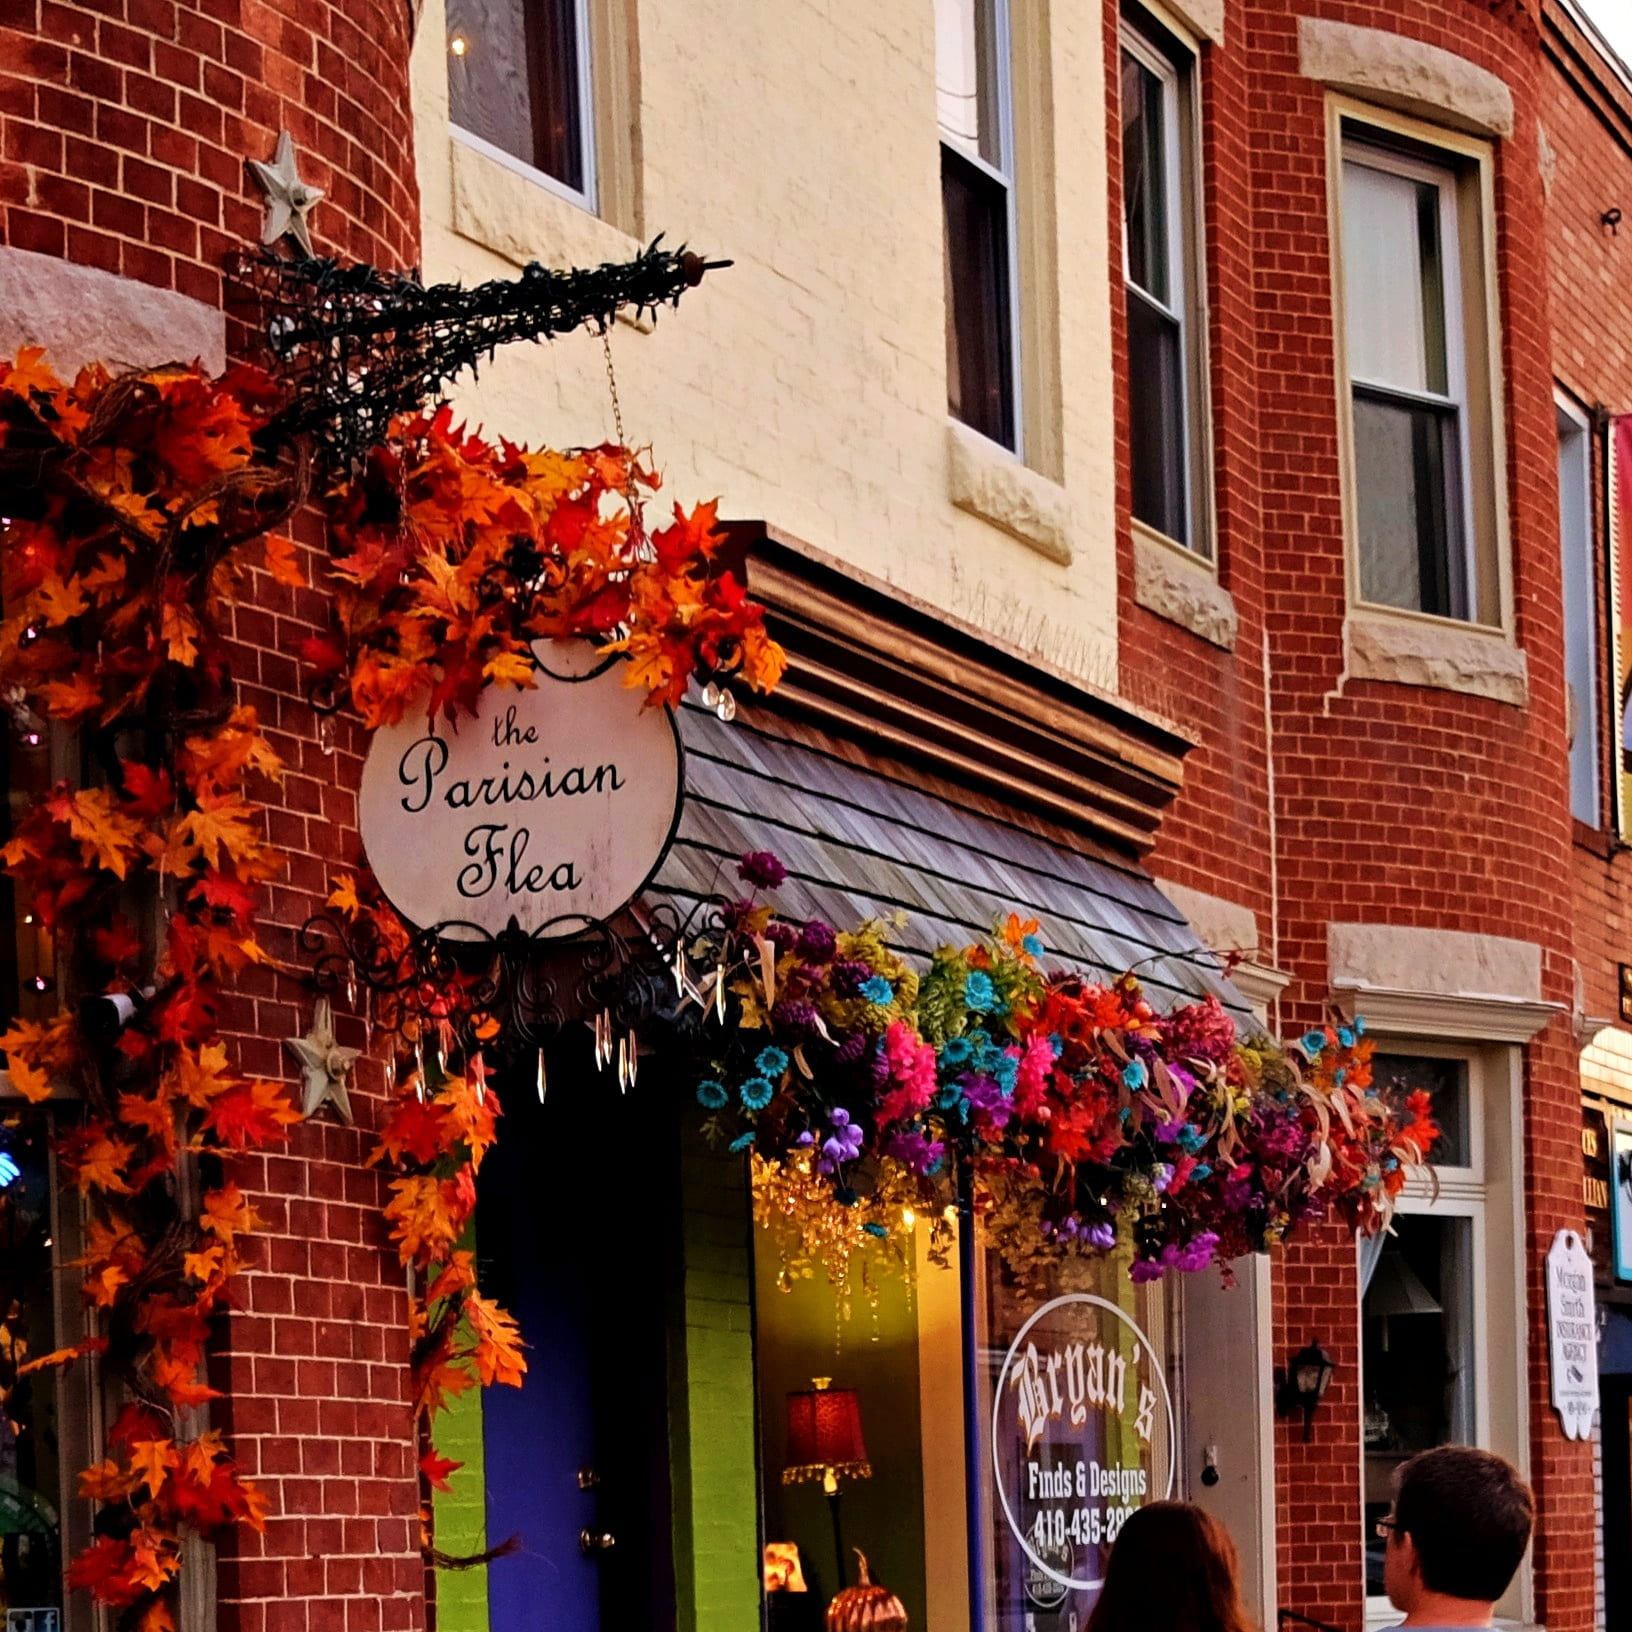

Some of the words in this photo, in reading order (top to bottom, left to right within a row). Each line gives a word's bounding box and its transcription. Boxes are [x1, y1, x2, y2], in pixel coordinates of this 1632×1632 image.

[491, 704, 539, 748] the
[398, 735, 626, 814] Parisian
[456, 823, 583, 898] Flea
[1010, 1340, 1158, 1458] Bryan's
[1028, 1462, 1073, 1500] Finds
[1075, 1461, 1086, 1497] &
[1090, 1461, 1147, 1504] Designs
